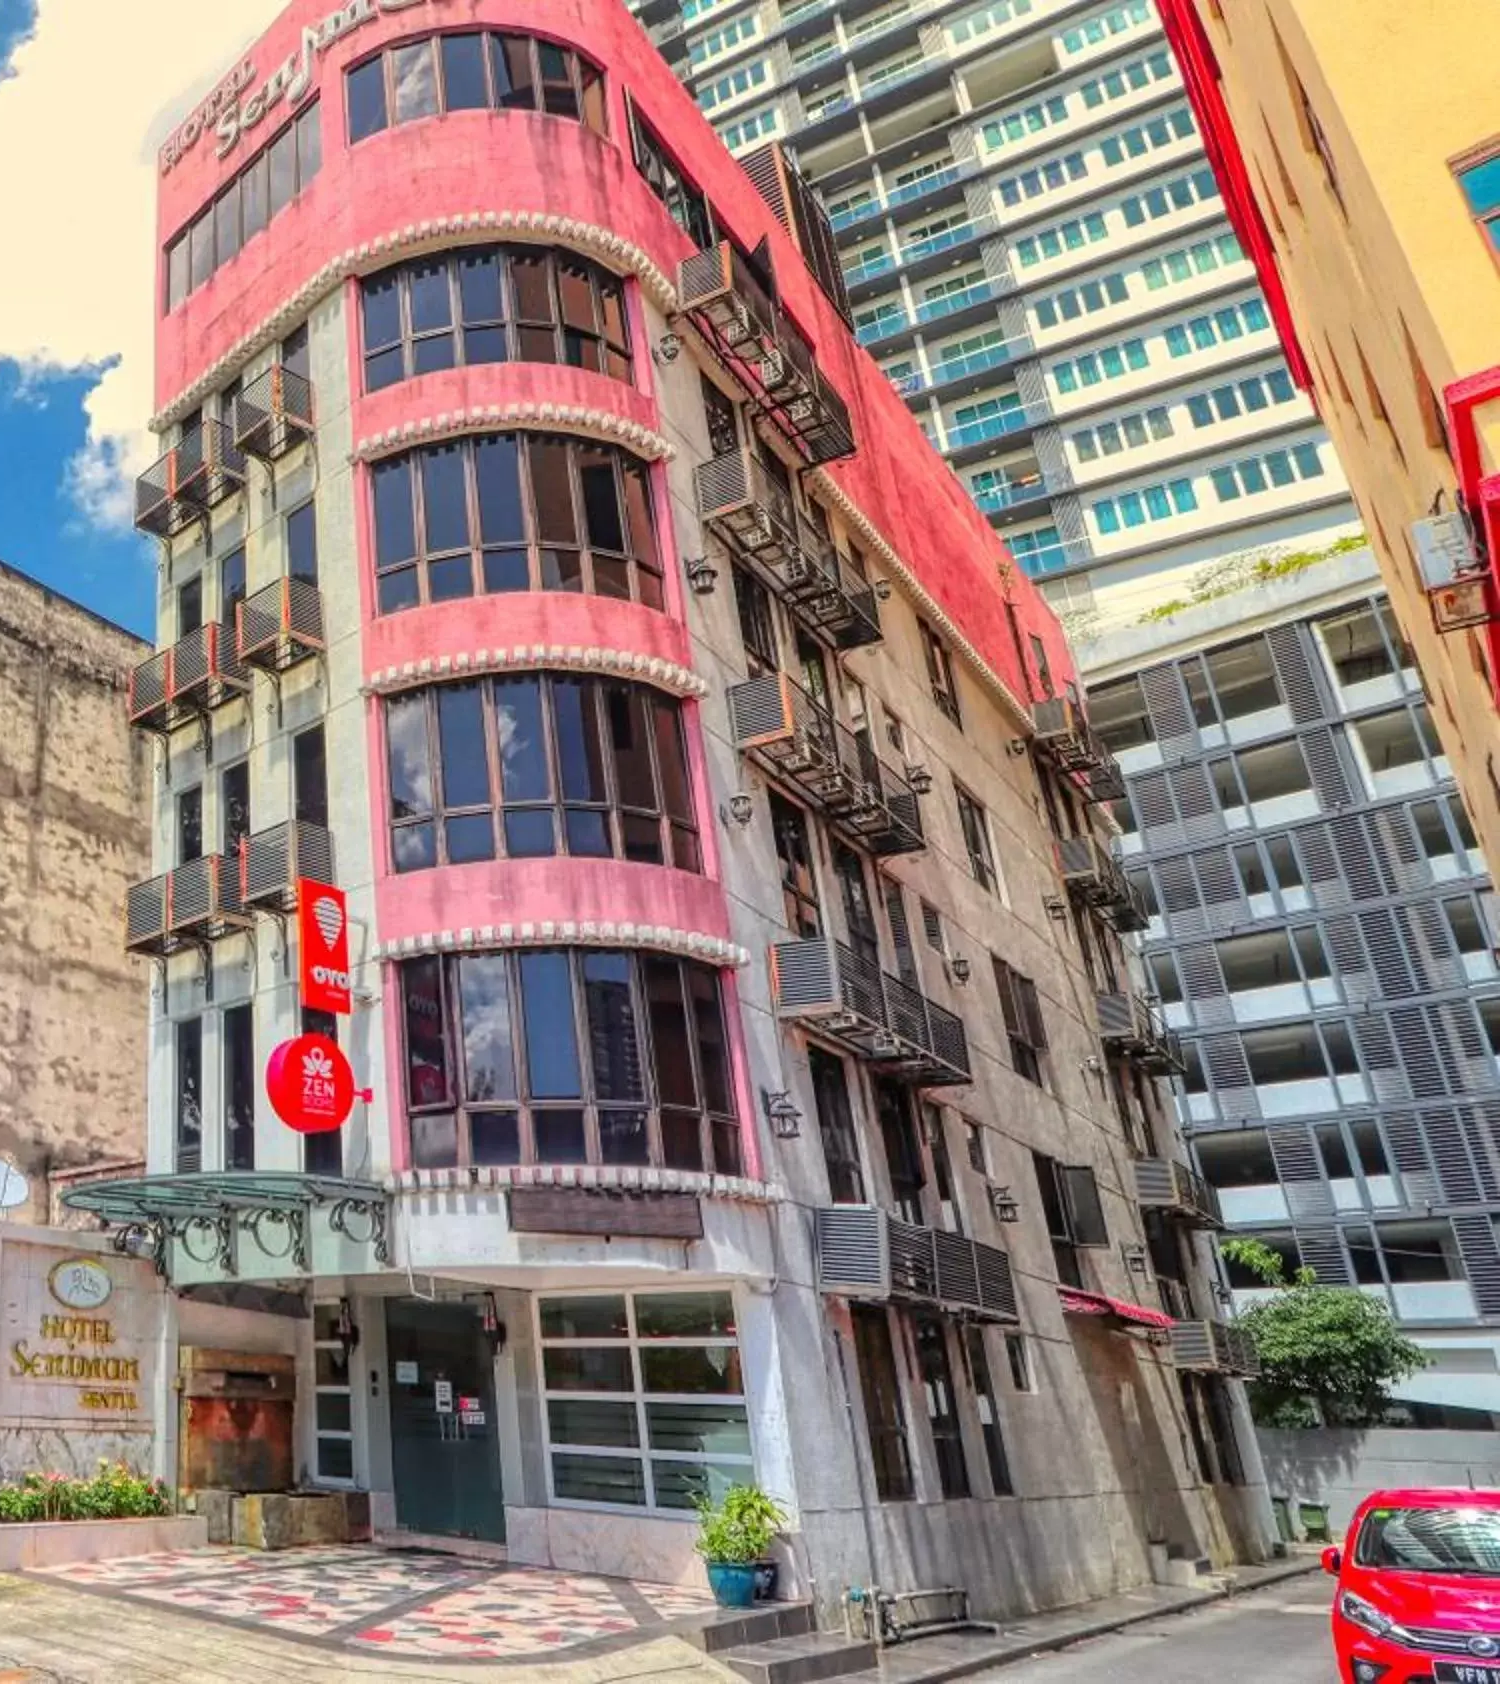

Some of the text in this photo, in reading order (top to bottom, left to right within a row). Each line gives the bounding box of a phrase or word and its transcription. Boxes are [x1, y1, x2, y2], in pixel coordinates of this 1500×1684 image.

[313, 965, 352, 987] OYO
[301, 1077, 336, 1099] ZEN
[40, 1313, 117, 1346] HOTEL
